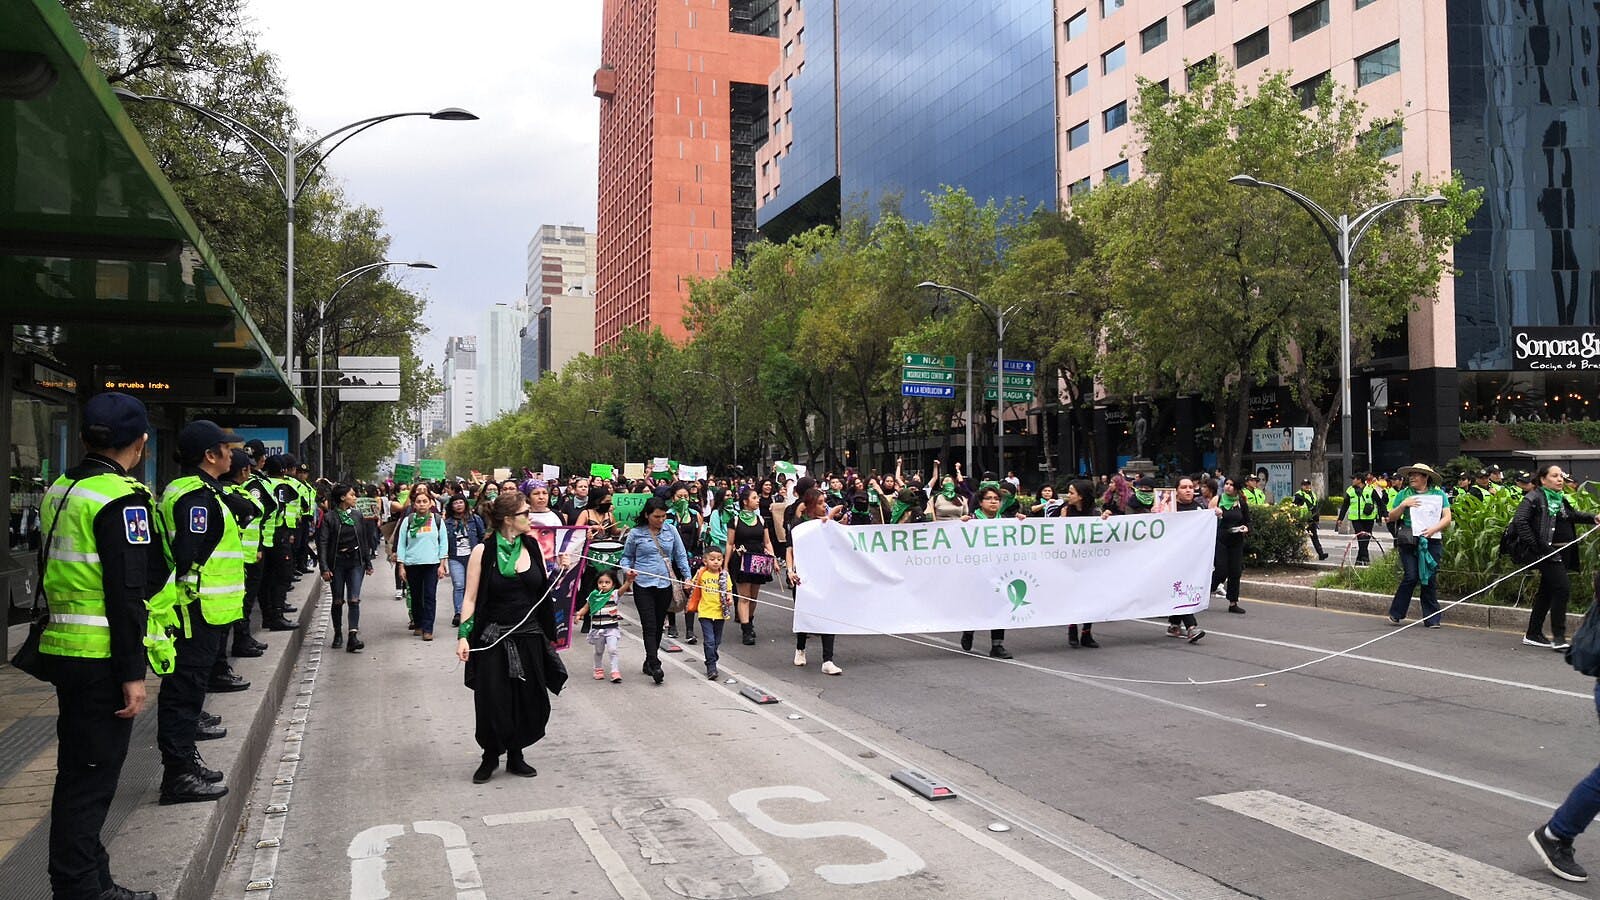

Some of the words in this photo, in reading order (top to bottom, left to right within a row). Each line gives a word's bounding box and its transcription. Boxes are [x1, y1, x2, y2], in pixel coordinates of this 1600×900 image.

[1515, 332, 1580, 359] Sonora
[1530, 361, 1563, 371] Cocina
[1566, 360, 1577, 369] de
[848, 527, 952, 553] MAREA
[960, 523, 1055, 549] VERDE
[904, 554, 951, 566] Aborto
[955, 552, 993, 566] Legal
[996, 552, 1009, 564] ya
[1013, 551, 1037, 562] para
[1041, 549, 1068, 560] todo
